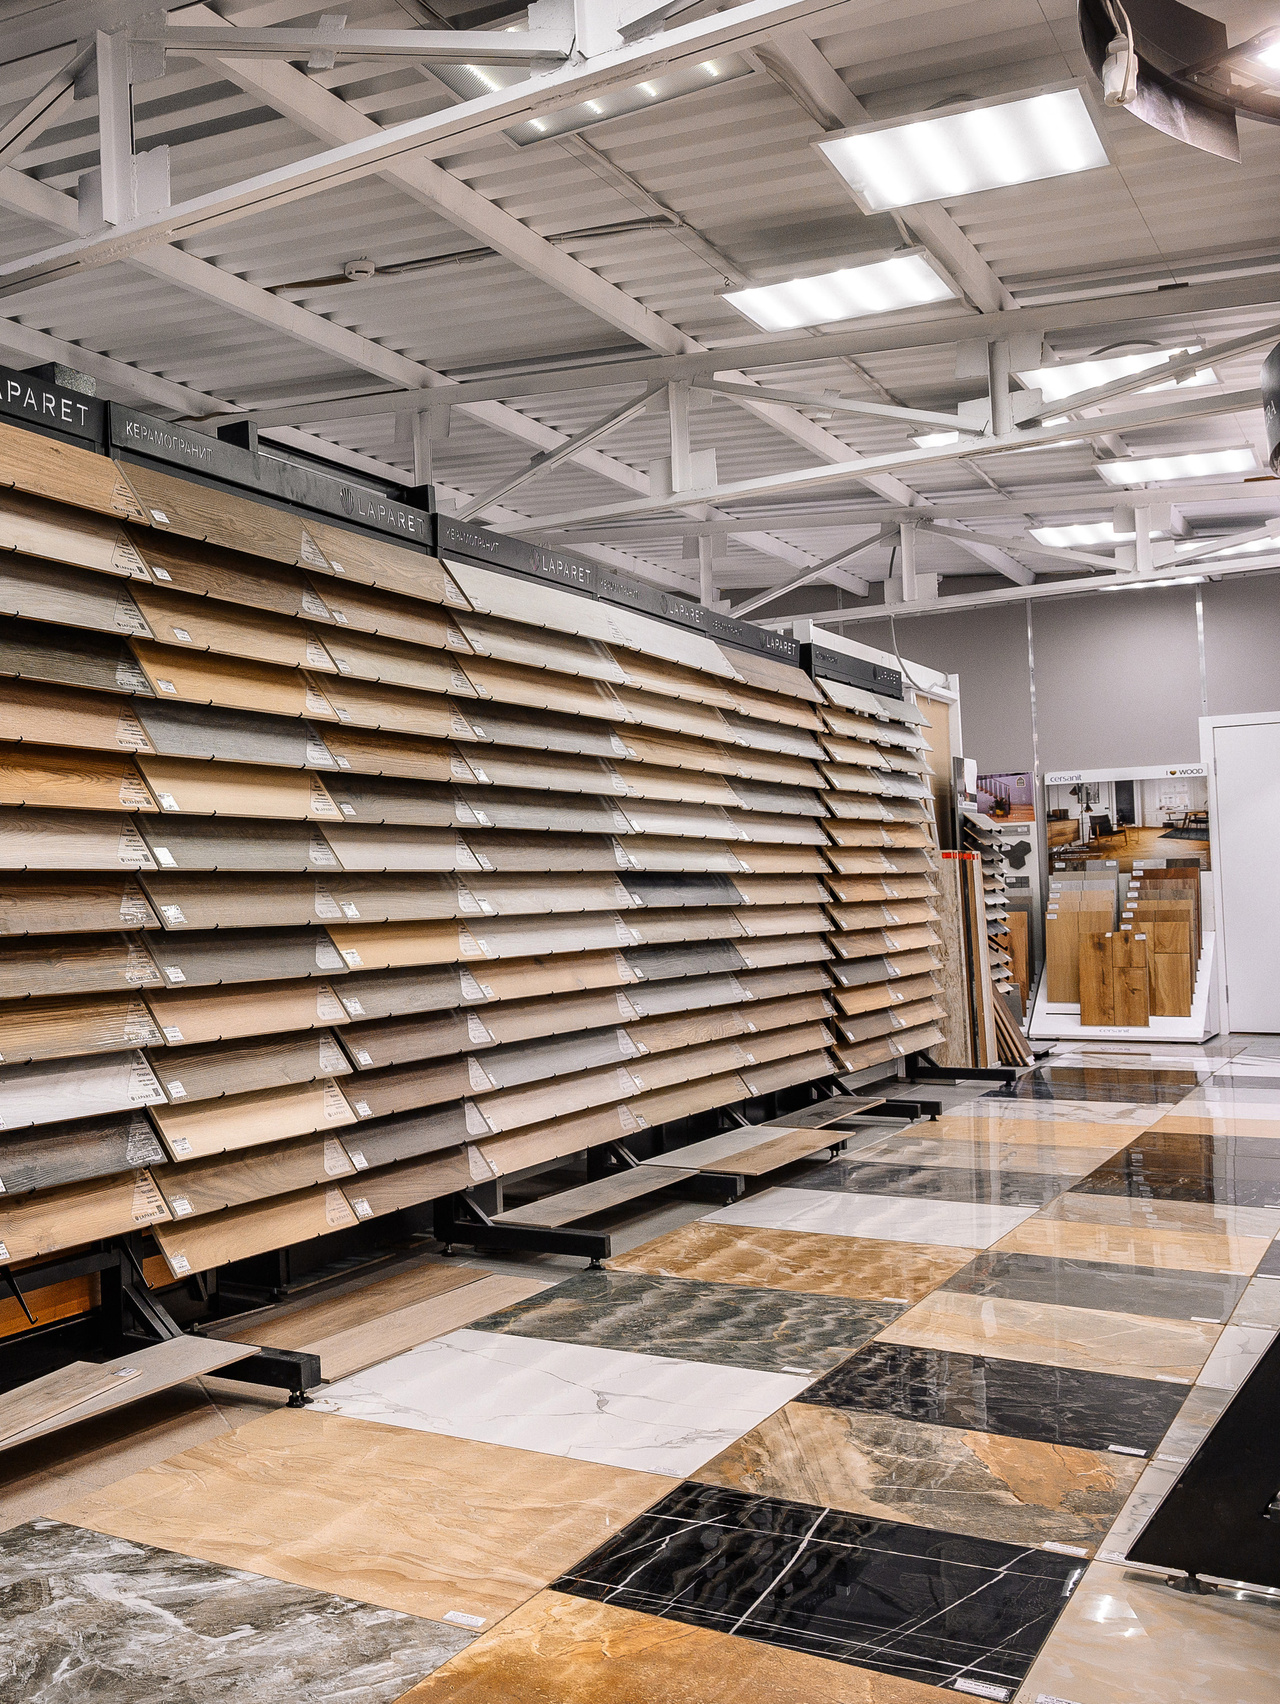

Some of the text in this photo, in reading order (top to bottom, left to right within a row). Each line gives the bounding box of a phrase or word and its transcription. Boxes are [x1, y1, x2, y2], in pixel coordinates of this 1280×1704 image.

[126, 421, 213, 462] КЕРАМОГРАНИТ
[357, 497, 424, 535] LAPARET
[542, 555, 590, 584] LAPARET
[767, 636, 796, 655] LAPARET
[1049, 773, 1083, 783] cersanit
[1178, 768, 1204, 776] WOOD
